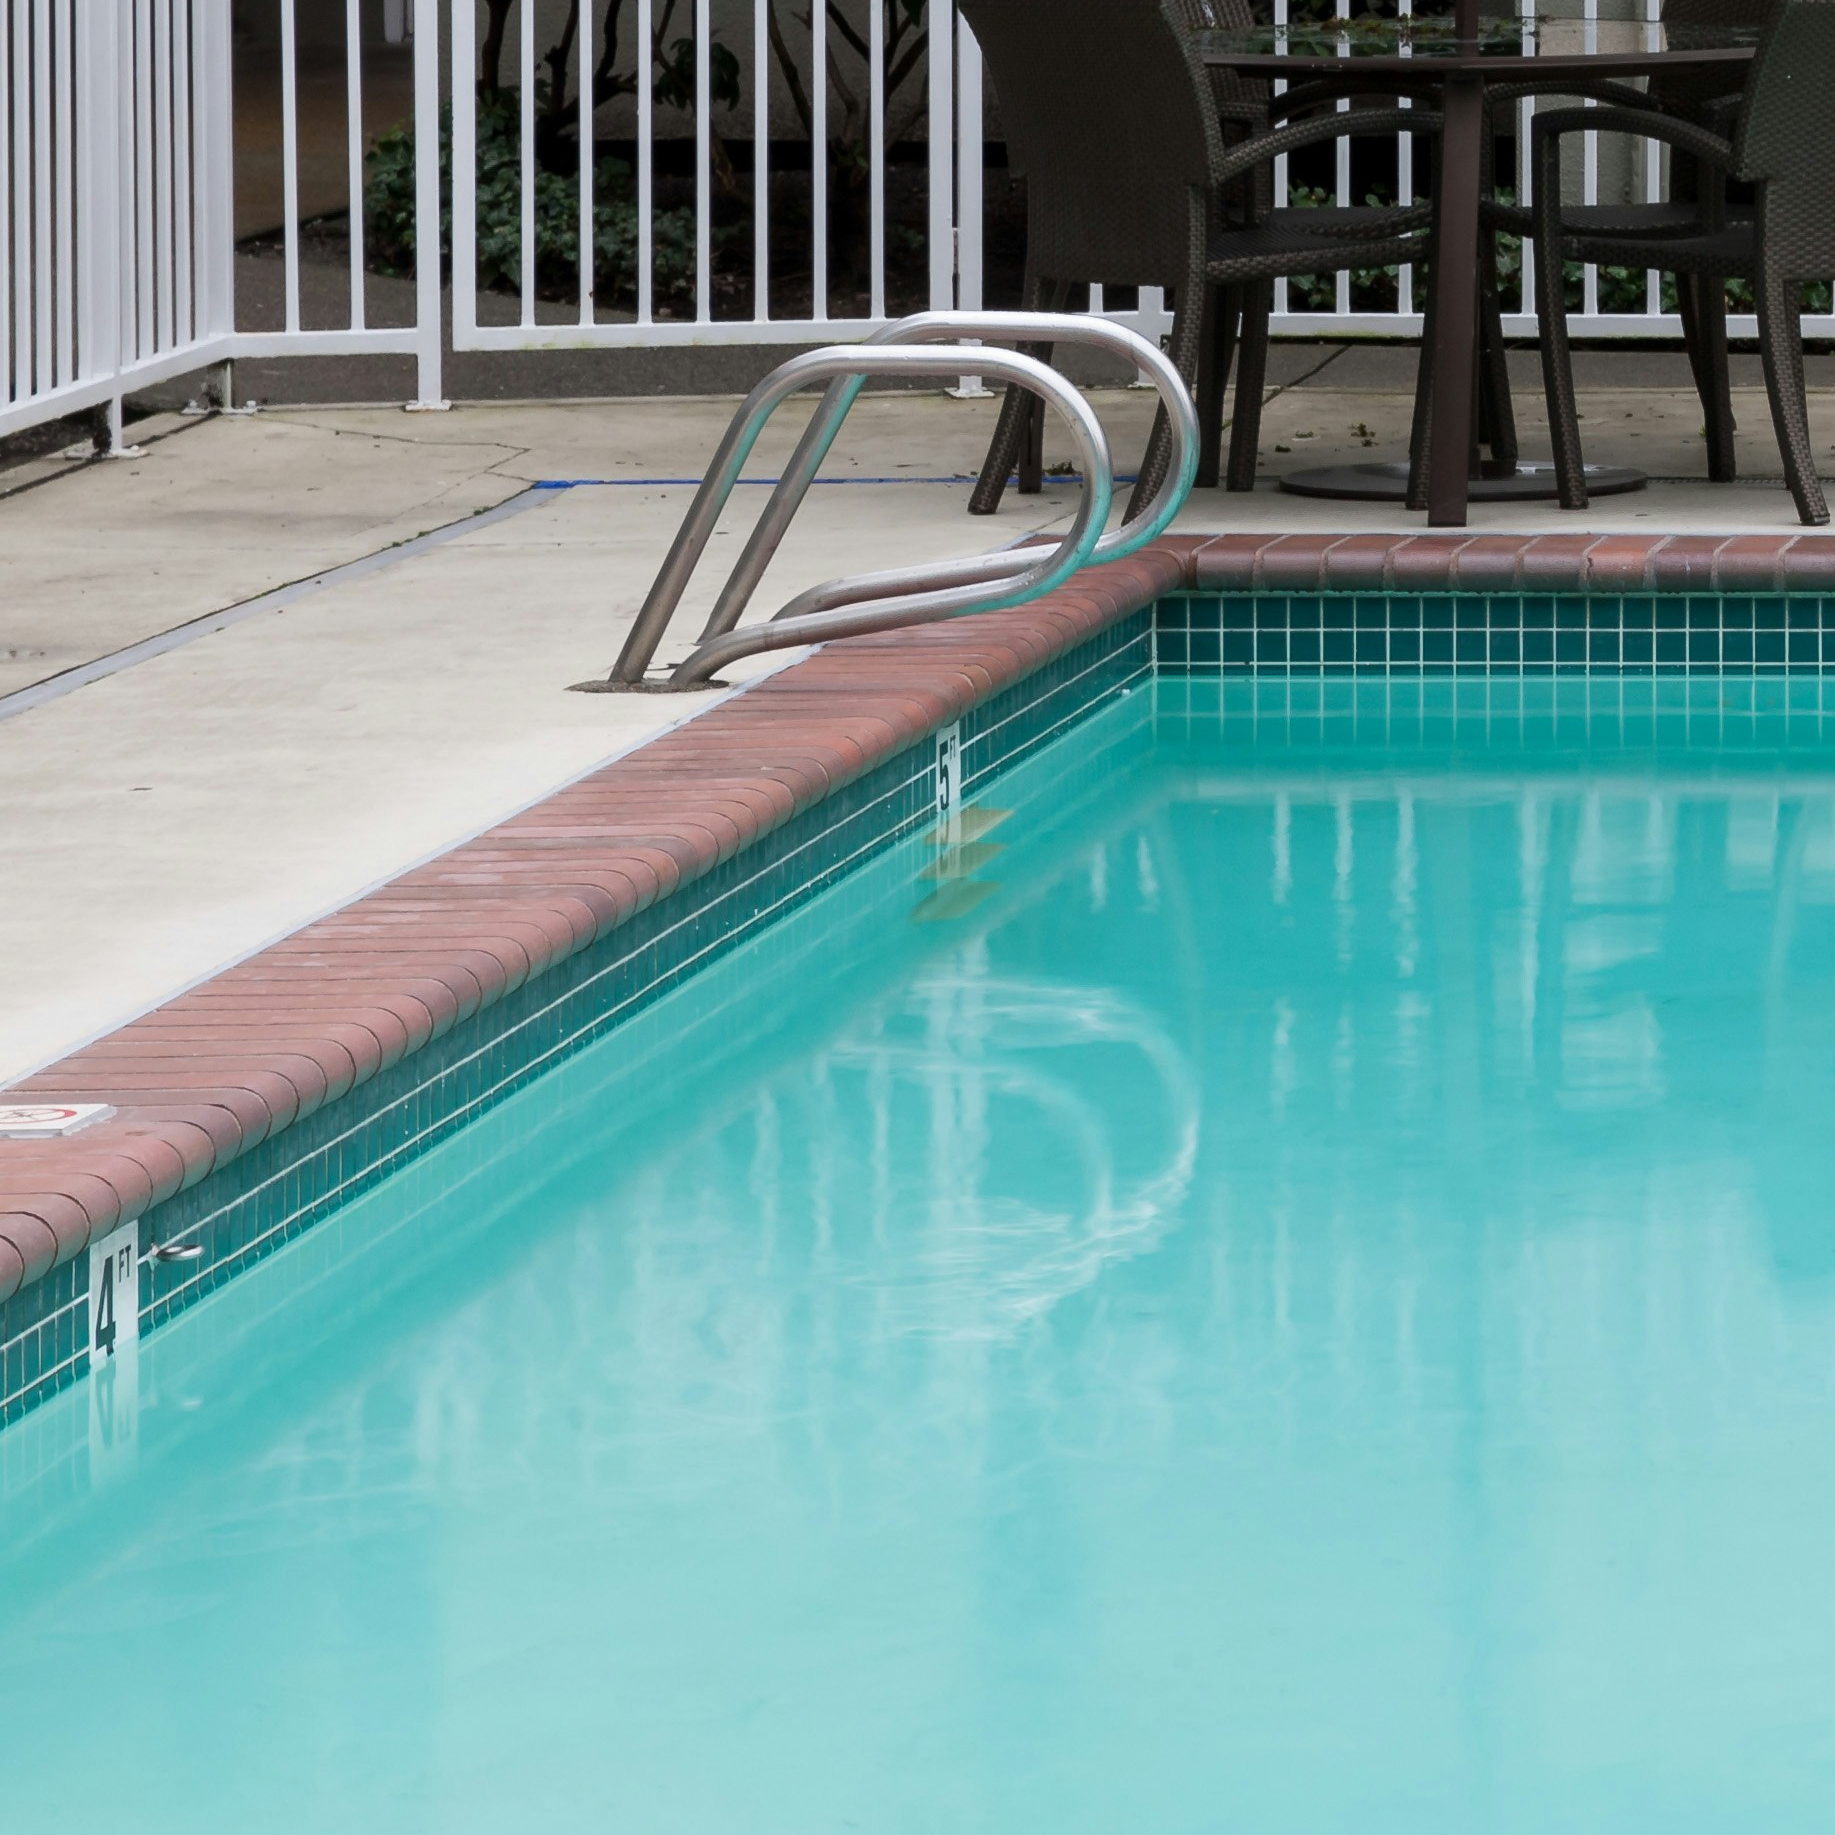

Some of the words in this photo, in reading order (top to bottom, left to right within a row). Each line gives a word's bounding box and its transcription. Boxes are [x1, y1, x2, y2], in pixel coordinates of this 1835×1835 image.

[938, 739, 950, 811] 5
[95, 1254, 117, 1357] 4
[118, 1243, 132, 1284] FT
